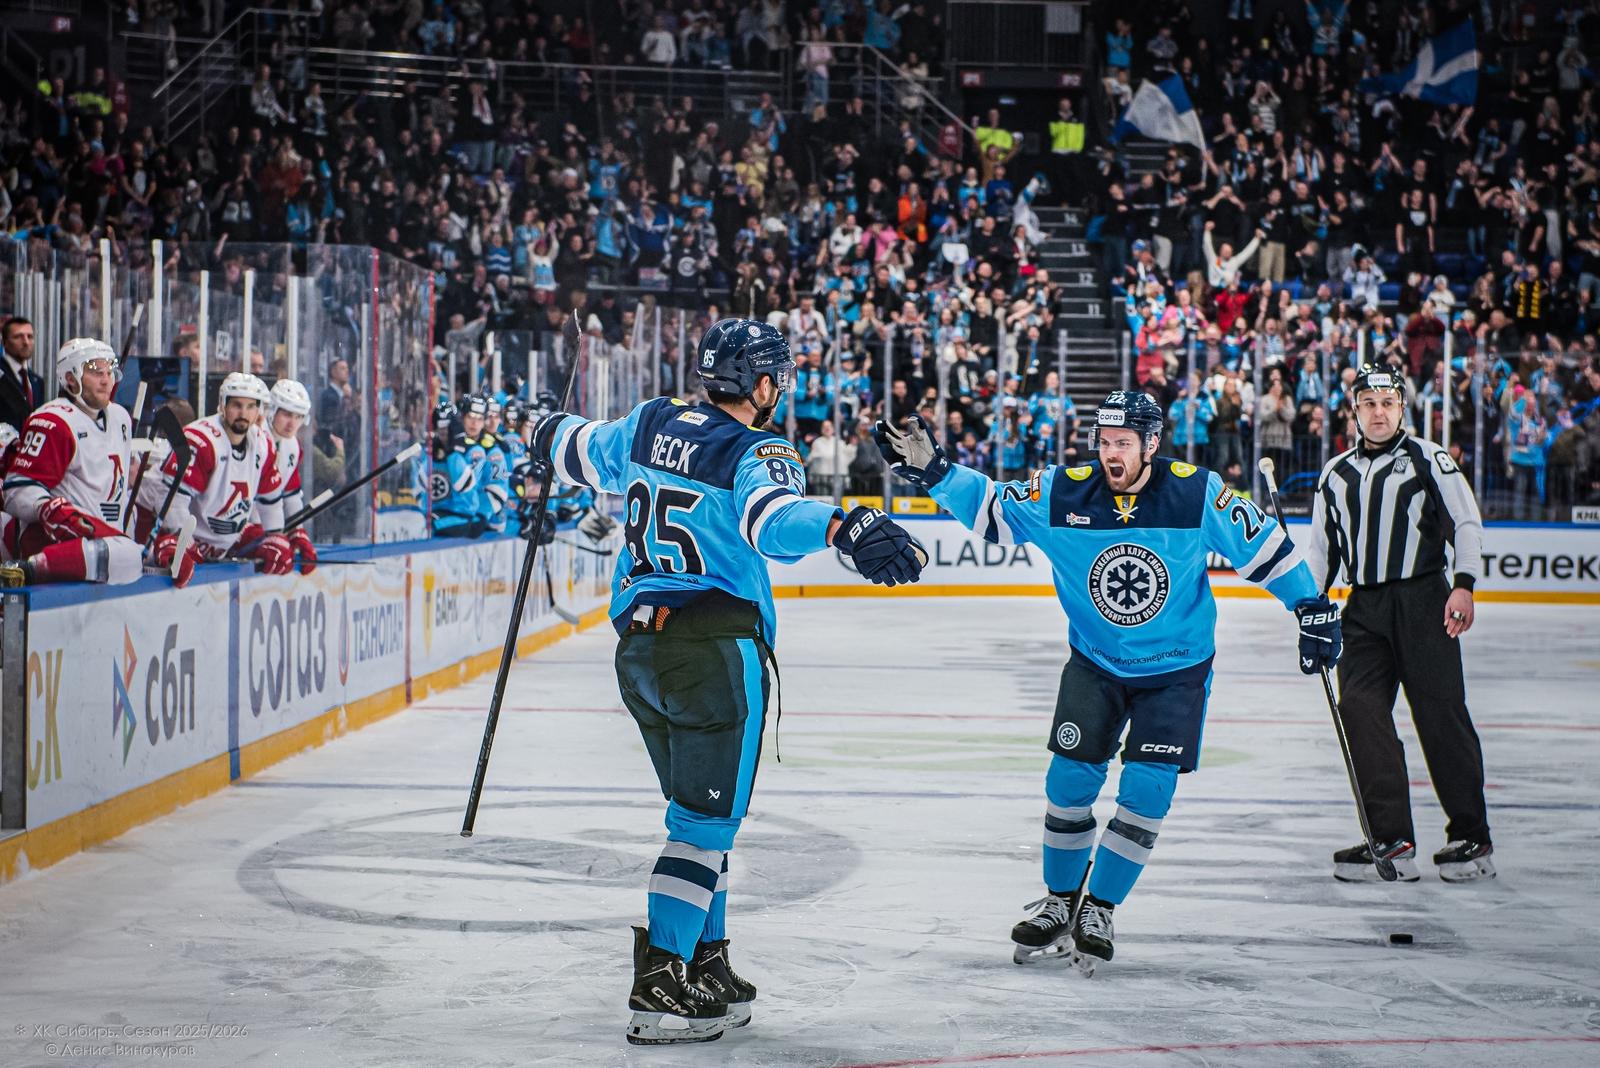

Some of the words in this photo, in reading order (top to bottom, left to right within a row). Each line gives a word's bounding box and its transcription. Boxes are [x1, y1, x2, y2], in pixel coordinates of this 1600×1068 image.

[703, 348, 716, 368] 85
[21, 430, 47, 457] 99
[650, 433, 699, 474] BECK
[624, 478, 707, 577] 85
[935, 540, 1032, 567] LADA
[1091, 545, 1126, 580] ХОККЕЙНЫЙ
[1127, 546, 1148, 559] КЛУБ
[1146, 555, 1167, 583] СИБИРЬ
[1481, 553, 1600, 581] телек
[1091, 587, 1142, 624] НОВОСИБИРСКАЯ
[1142, 589, 1167, 619] ОБЛАСТЬ
[249, 591, 326, 719] согаз
[145, 623, 195, 746] сбп
[1140, 743, 1183, 754] CCM
[704, 972, 725, 993] CCM
[651, 986, 689, 1015] CCM
